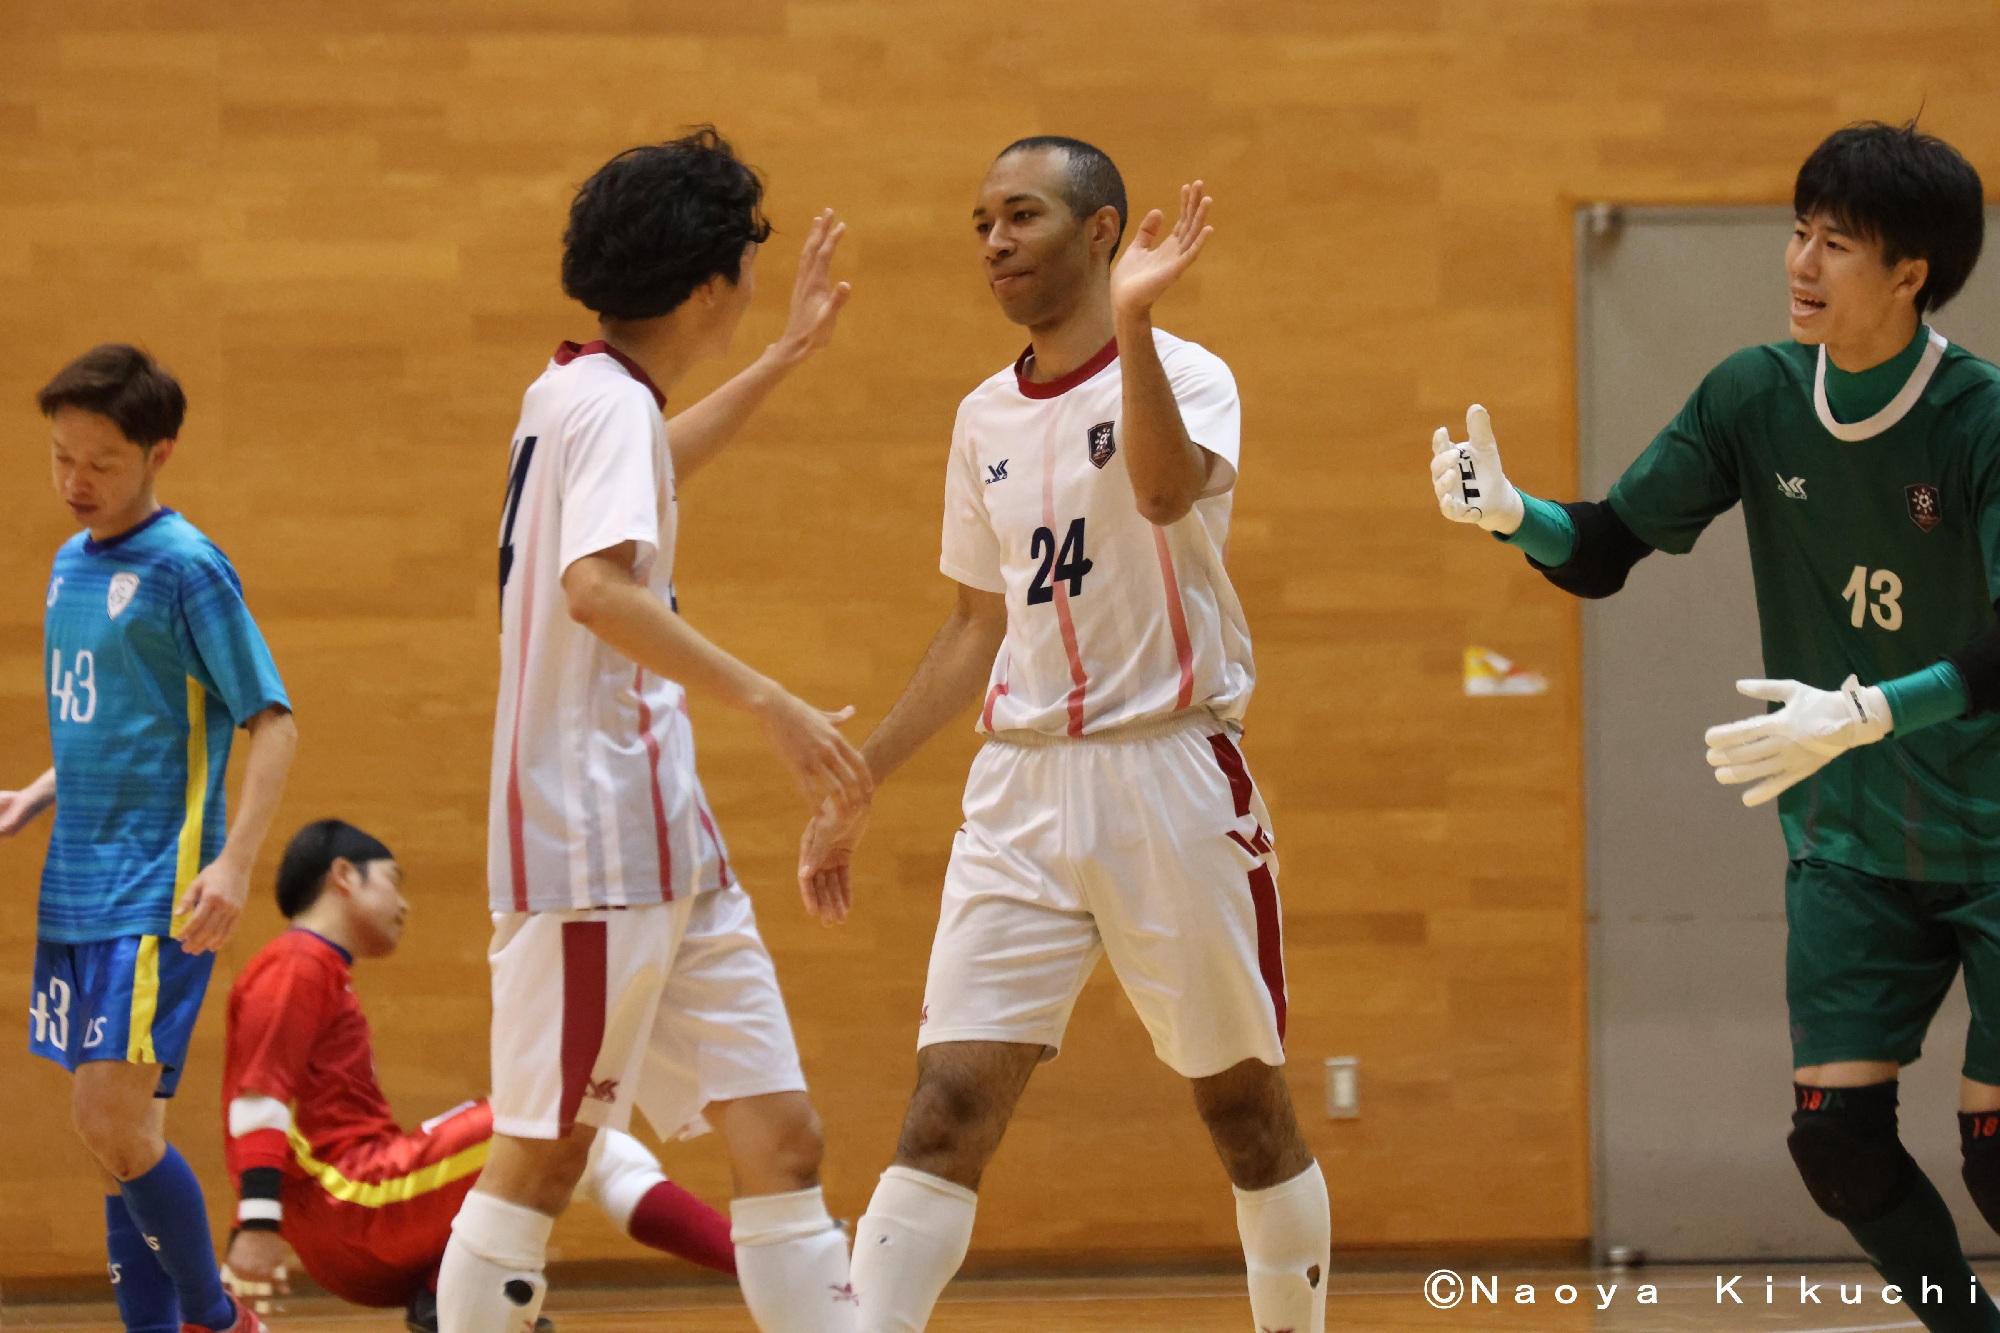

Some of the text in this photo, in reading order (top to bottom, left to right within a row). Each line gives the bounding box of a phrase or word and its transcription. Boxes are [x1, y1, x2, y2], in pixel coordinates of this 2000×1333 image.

[1027, 517, 1093, 606] 24
[1841, 565, 1903, 631] 13
[51, 648, 97, 723] 43
